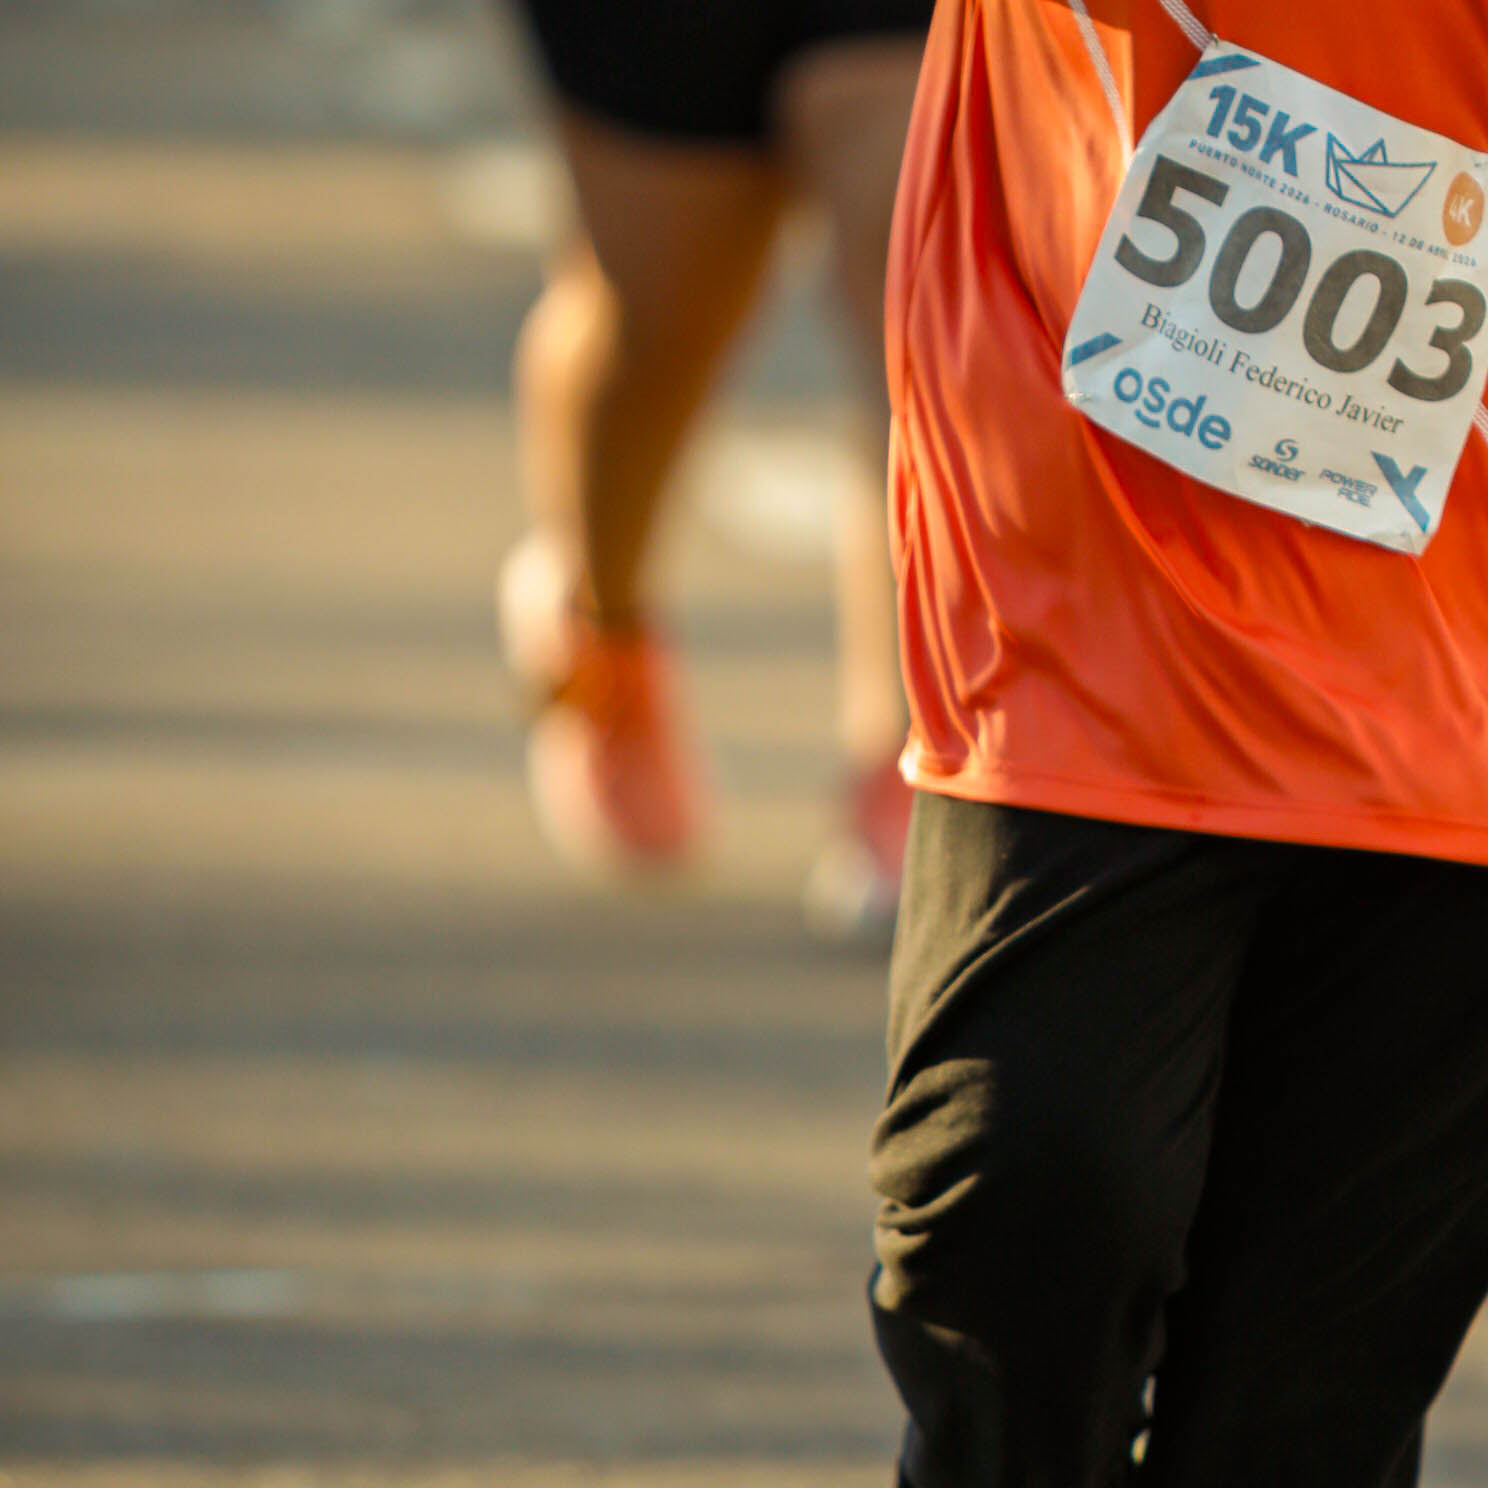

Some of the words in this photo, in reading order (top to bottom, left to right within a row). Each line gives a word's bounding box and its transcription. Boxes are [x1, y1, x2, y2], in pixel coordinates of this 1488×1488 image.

[1205, 83, 1319, 178] 15K
[1189, 138, 1238, 167] PUERTO
[1241, 163, 1277, 188] NORTE
[1323, 202, 1379, 233] ROSARIO
[1113, 153, 1488, 402] 5003
[1113, 367, 1232, 450] osde
[1140, 303, 1228, 366] Biagioli
[1228, 350, 1332, 409] Federico
[1336, 394, 1405, 434] Javier
